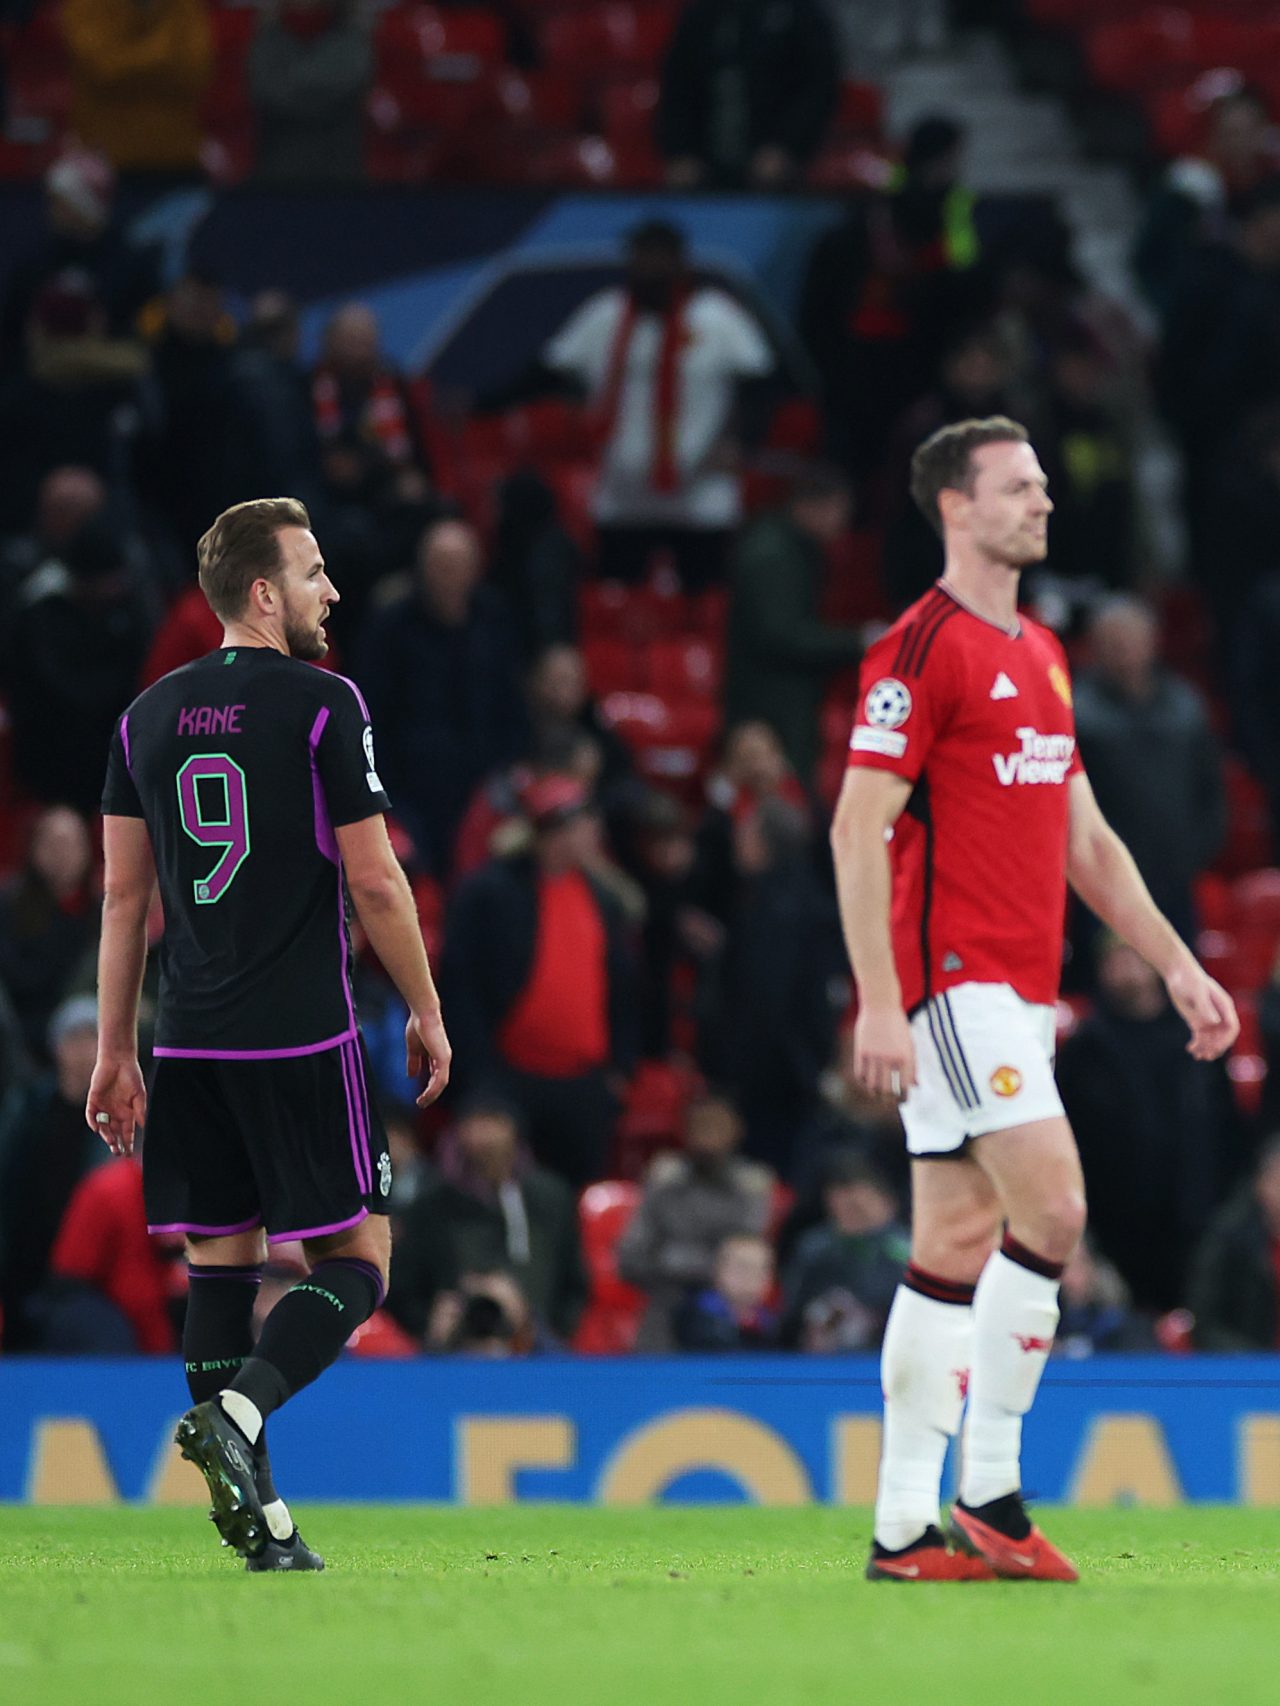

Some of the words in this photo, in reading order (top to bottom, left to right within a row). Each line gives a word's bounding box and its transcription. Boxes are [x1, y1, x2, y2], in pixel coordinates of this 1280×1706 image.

[177, 704, 246, 736] KANE
[176, 753, 250, 904] 9
[288, 1284, 344, 1312] AYERN
[202, 1356, 247, 1371] BAYE
